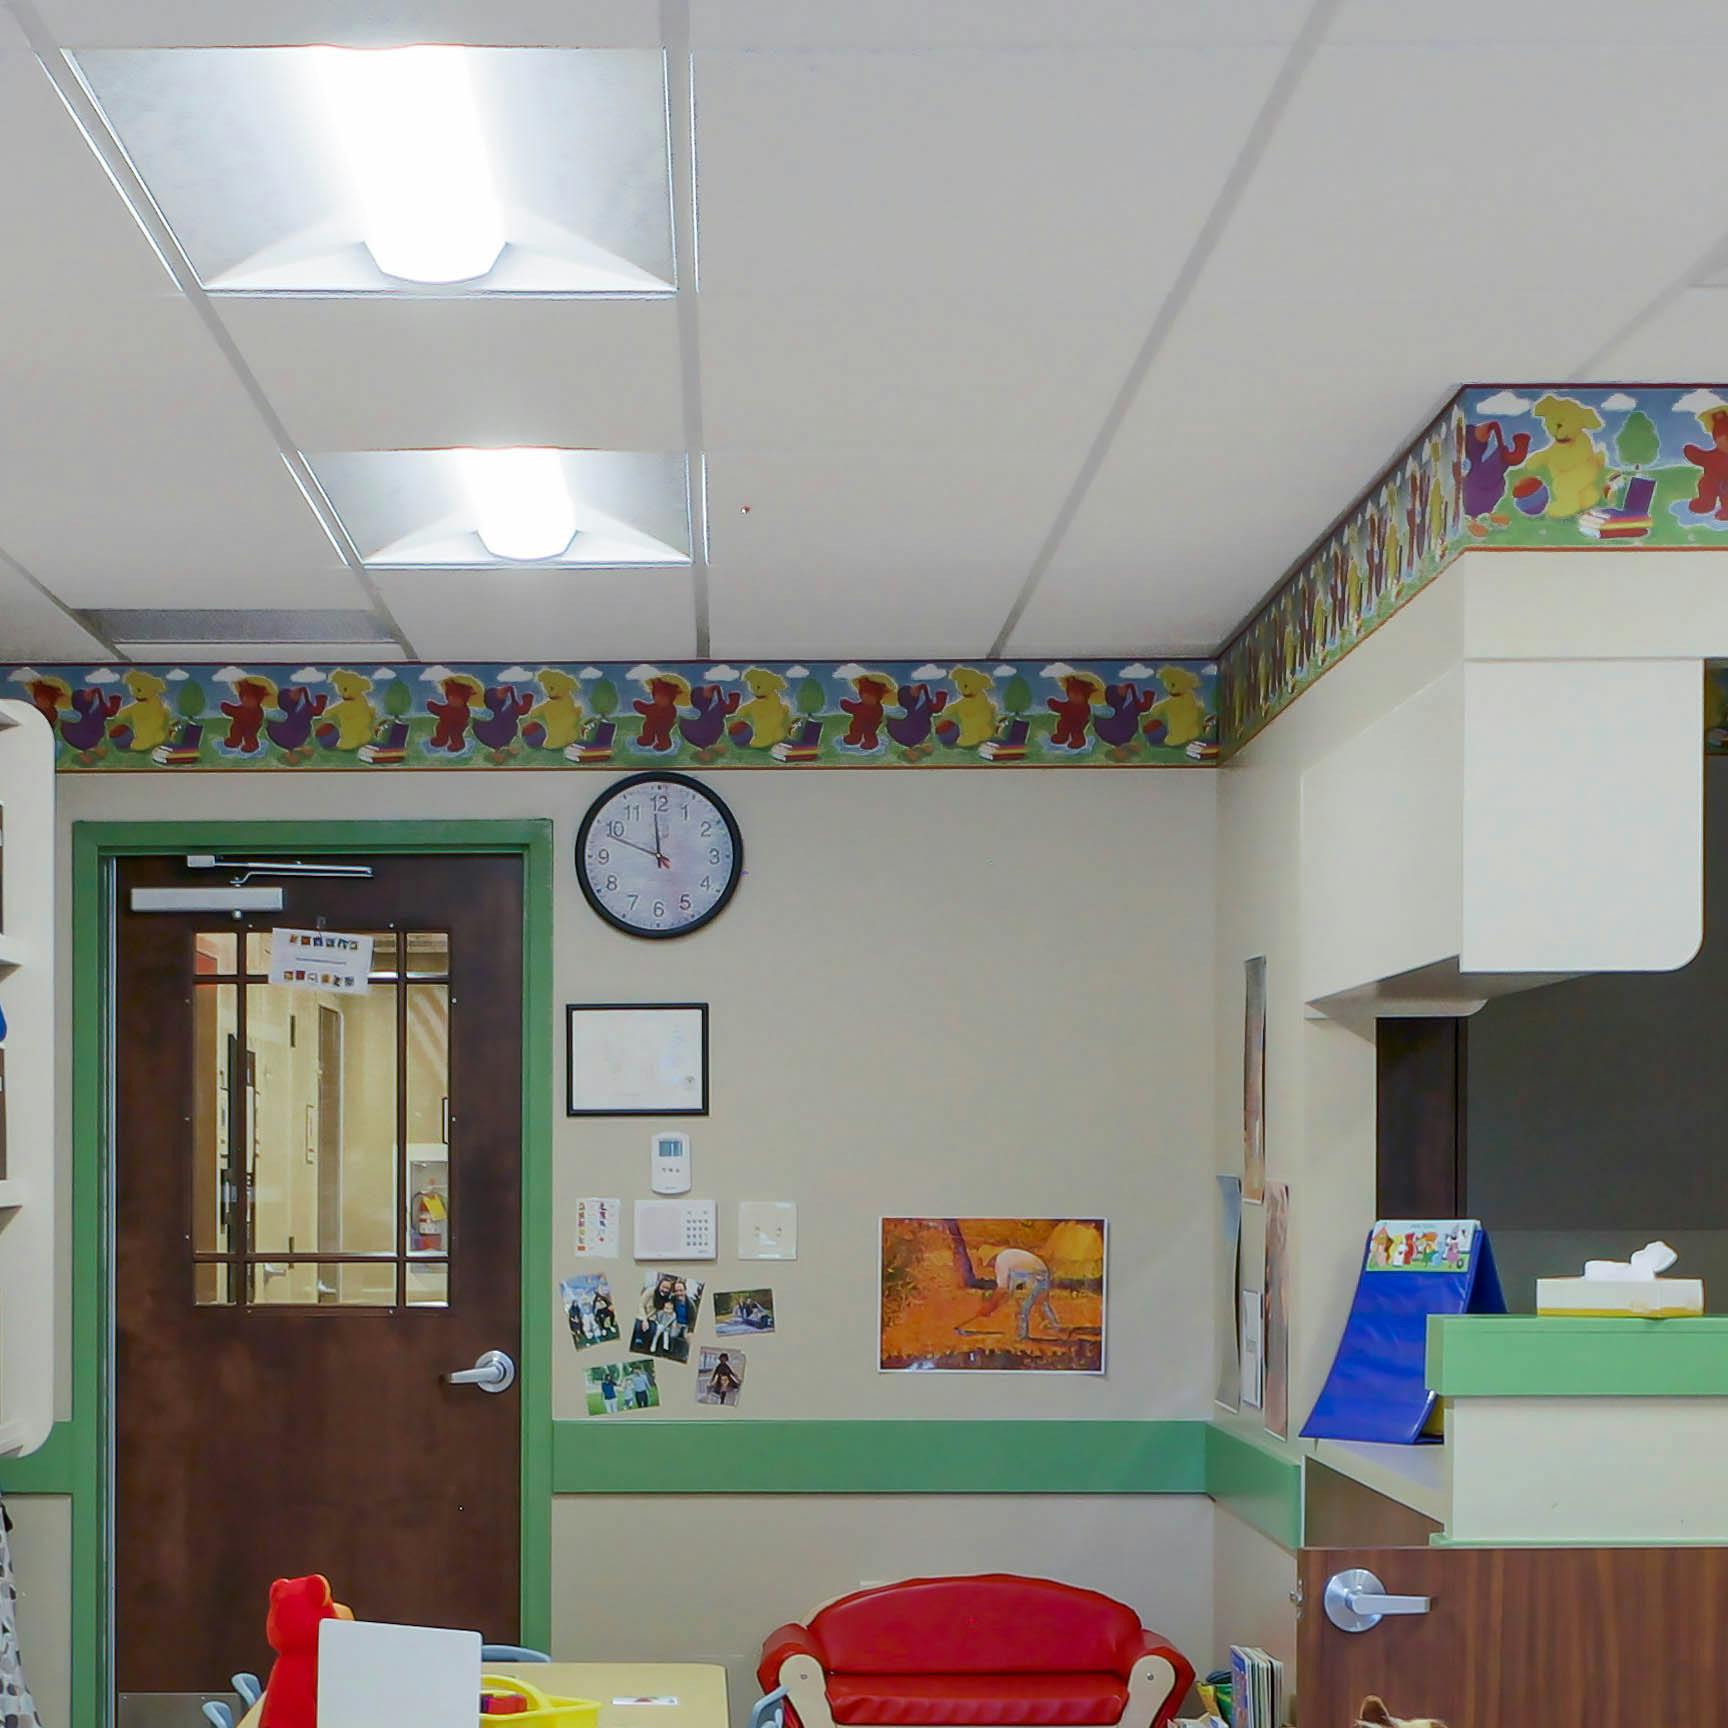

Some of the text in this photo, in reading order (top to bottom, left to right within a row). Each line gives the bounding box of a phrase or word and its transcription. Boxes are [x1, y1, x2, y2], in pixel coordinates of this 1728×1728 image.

[650, 795, 669, 813] 12
[680, 804, 689, 821] 1
[624, 804, 641, 822] 11
[606, 820, 625, 838] 10
[700, 820, 713, 838] 2
[598, 848, 610, 865] 9
[709, 848, 721, 865] 3
[606, 875, 618, 892] 8
[700, 875, 712, 891] 4
[627, 894, 640, 911] 7
[653, 901, 665, 918] 6
[679, 893, 692, 911] 5
